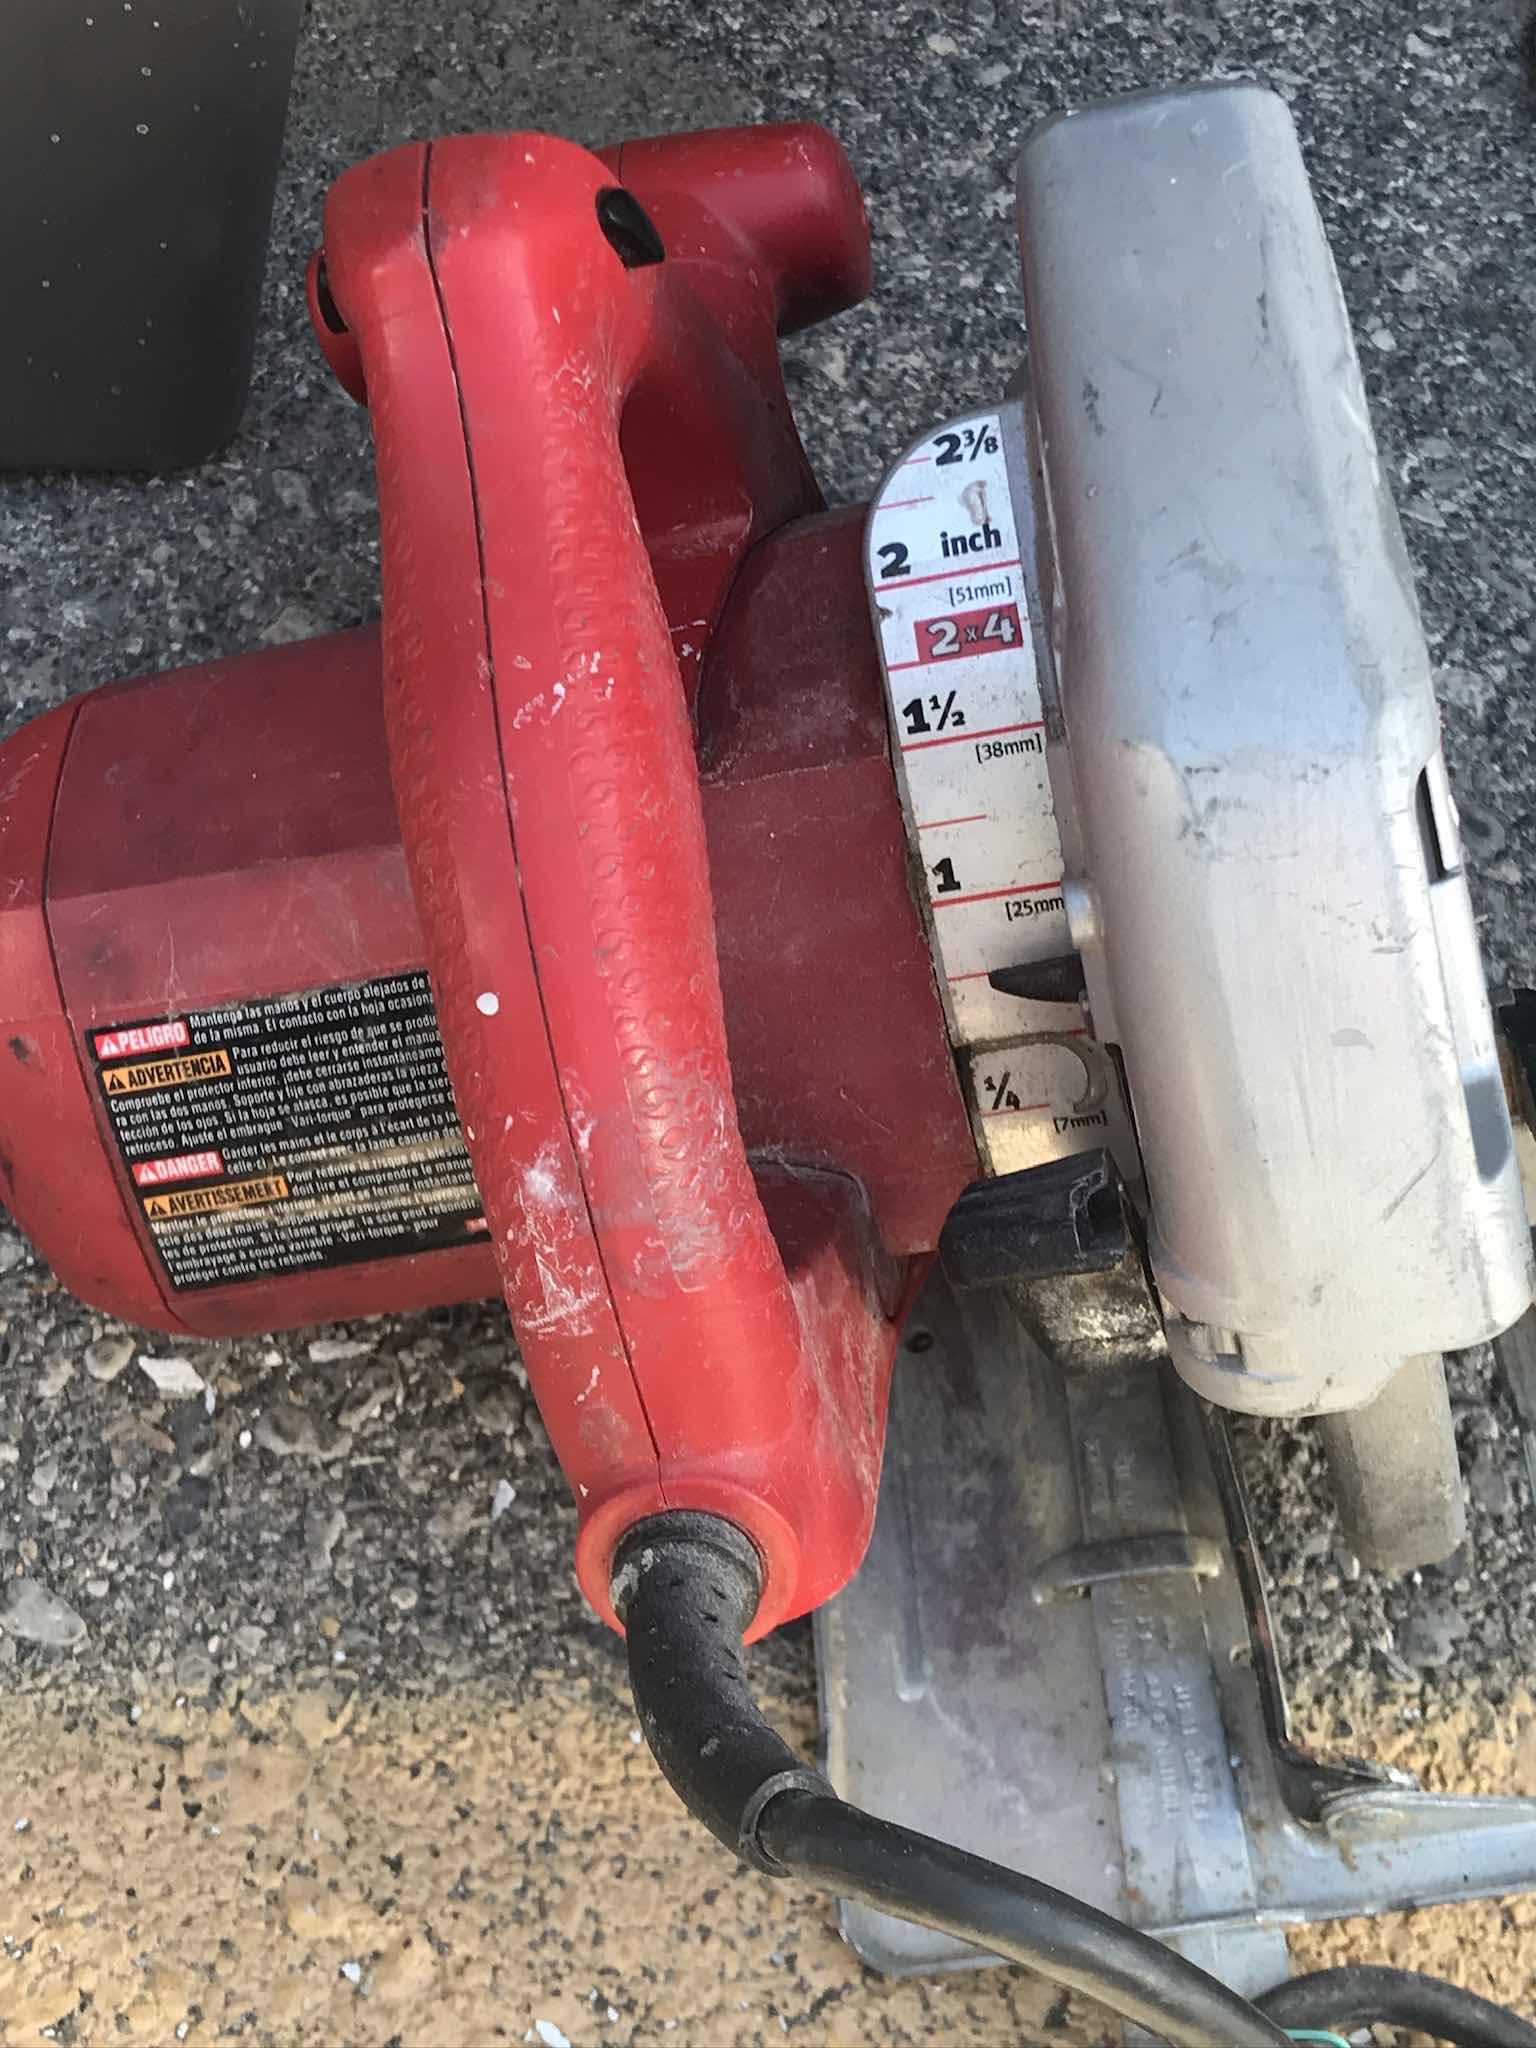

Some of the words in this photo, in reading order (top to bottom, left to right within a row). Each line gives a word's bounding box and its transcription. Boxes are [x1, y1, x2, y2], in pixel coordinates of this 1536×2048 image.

[876, 542, 912, 579] 2
[940, 524, 1002, 558] inch
[931, 857, 962, 893] 1
[190, 1009, 242, 1027] Mantenga
[244, 1007, 261, 1018] las
[264, 1001, 299, 1014] manos
[301, 999, 308, 1011] y
[310, 994, 321, 1007] el
[324, 990, 360, 1005] cuerpo
[363, 981, 409, 998] alejados
[411, 978, 424, 989] de
[118, 1023, 185, 1050] PELIGRO
[194, 1031, 207, 1044] de
[209, 1028, 220, 1041] la
[265, 1018, 276, 1031] El
[279, 1012, 323, 1029] contacto
[326, 1009, 345, 1021] con
[348, 1005, 359, 1017] la
[361, 1001, 385, 1015] hoja
[232, 1046, 257, 1059] Para
[260, 1039, 297, 1054] reducir
[301, 1034, 311, 1048] el
[314, 1030, 348, 1045] riesgo
[350, 1026, 363, 1039] de
[367, 1024, 386, 1039] que
[389, 1021, 402, 1032] se
[128, 1055, 225, 1086] ADVERTENCIA
[237, 1059, 276, 1074] usuario
[280, 1054, 305, 1067] debe
[308, 1050, 329, 1062] leer
[332, 1049, 338, 1061] y
[342, 1040, 388, 1056] entender
[392, 1035, 402, 1048] el
[111, 1093, 170, 1112] Compruebe
[174, 1089, 184, 1102] el
[187, 1082, 235, 1101] protector
[315, 1061, 359, 1077] cerrarse
[116, 1116, 127, 1126] ra
[130, 1113, 148, 1124] con
[150, 1109, 167, 1120] las
[170, 1106, 189, 1117] dos
[233, 1090, 274, 1107] Soporte
[277, 1089, 283, 1102] y
[306, 1082, 326, 1094] con
[395, 1067, 407, 1079] la
[409, 1063, 438, 1079] pieza
[161, 1122, 174, 1134] de
[176, 1120, 193, 1131] los
[224, 1111, 236, 1123] Si
[238, 1110, 249, 1121] la
[251, 1106, 275, 1119] hoja
[277, 1104, 290, 1115] se
[334, 1094, 347, 1105] es
[350, 1087, 389, 1105] posible
[392, 1084, 411, 1097] que
[414, 1080, 425, 1091] la
[217, 1127, 227, 1140] el
[230, 1121, 282, 1138] embrague
[360, 1104, 384, 1118] para
[222, 1145, 257, 1159] Garder
[259, 1142, 276, 1153] les
[279, 1137, 311, 1150] mains
[314, 1132, 324, 1145] et
[326, 1131, 337, 1142] le
[339, 1127, 368, 1140] corps
[416, 1115, 429, 1127] de
[432, 1113, 443, 1124] la
[272, 1155, 286, 1166] Le
[288, 1148, 326, 1163] contact
[355, 1142, 366, 1152] la
[155, 1153, 219, 1178] DANGER
[286, 1170, 312, 1182] Pour
[169, 1181, 281, 1212] AVERTISSEMENT
